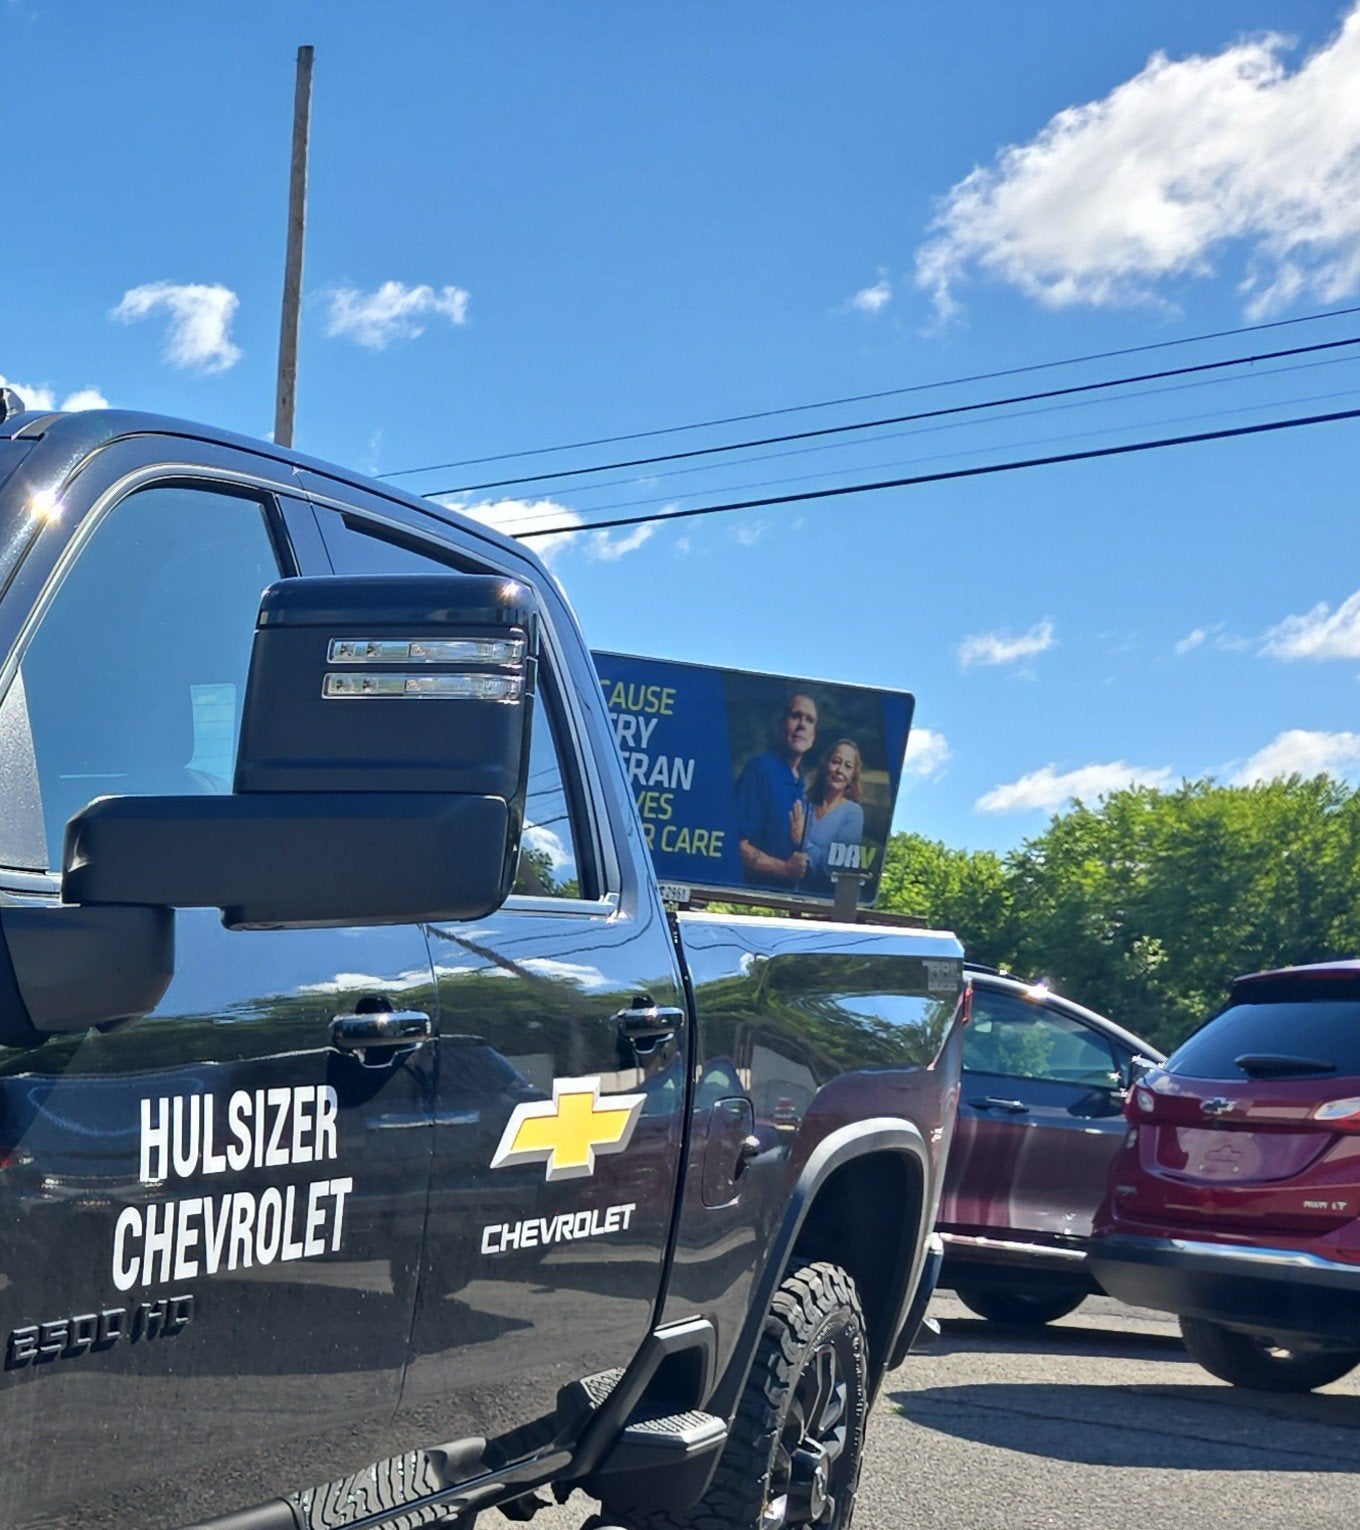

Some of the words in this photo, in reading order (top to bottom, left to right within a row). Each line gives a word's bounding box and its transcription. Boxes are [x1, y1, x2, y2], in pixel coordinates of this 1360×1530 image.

[660, 825, 726, 858] CARE
[827, 842, 877, 870] DAV
[139, 1084, 339, 1183] HULSIZER
[112, 1176, 354, 1292] CHEVROLET
[481, 1202, 637, 1255] CHEVROLET
[11, 1307, 128, 1362] 2500
